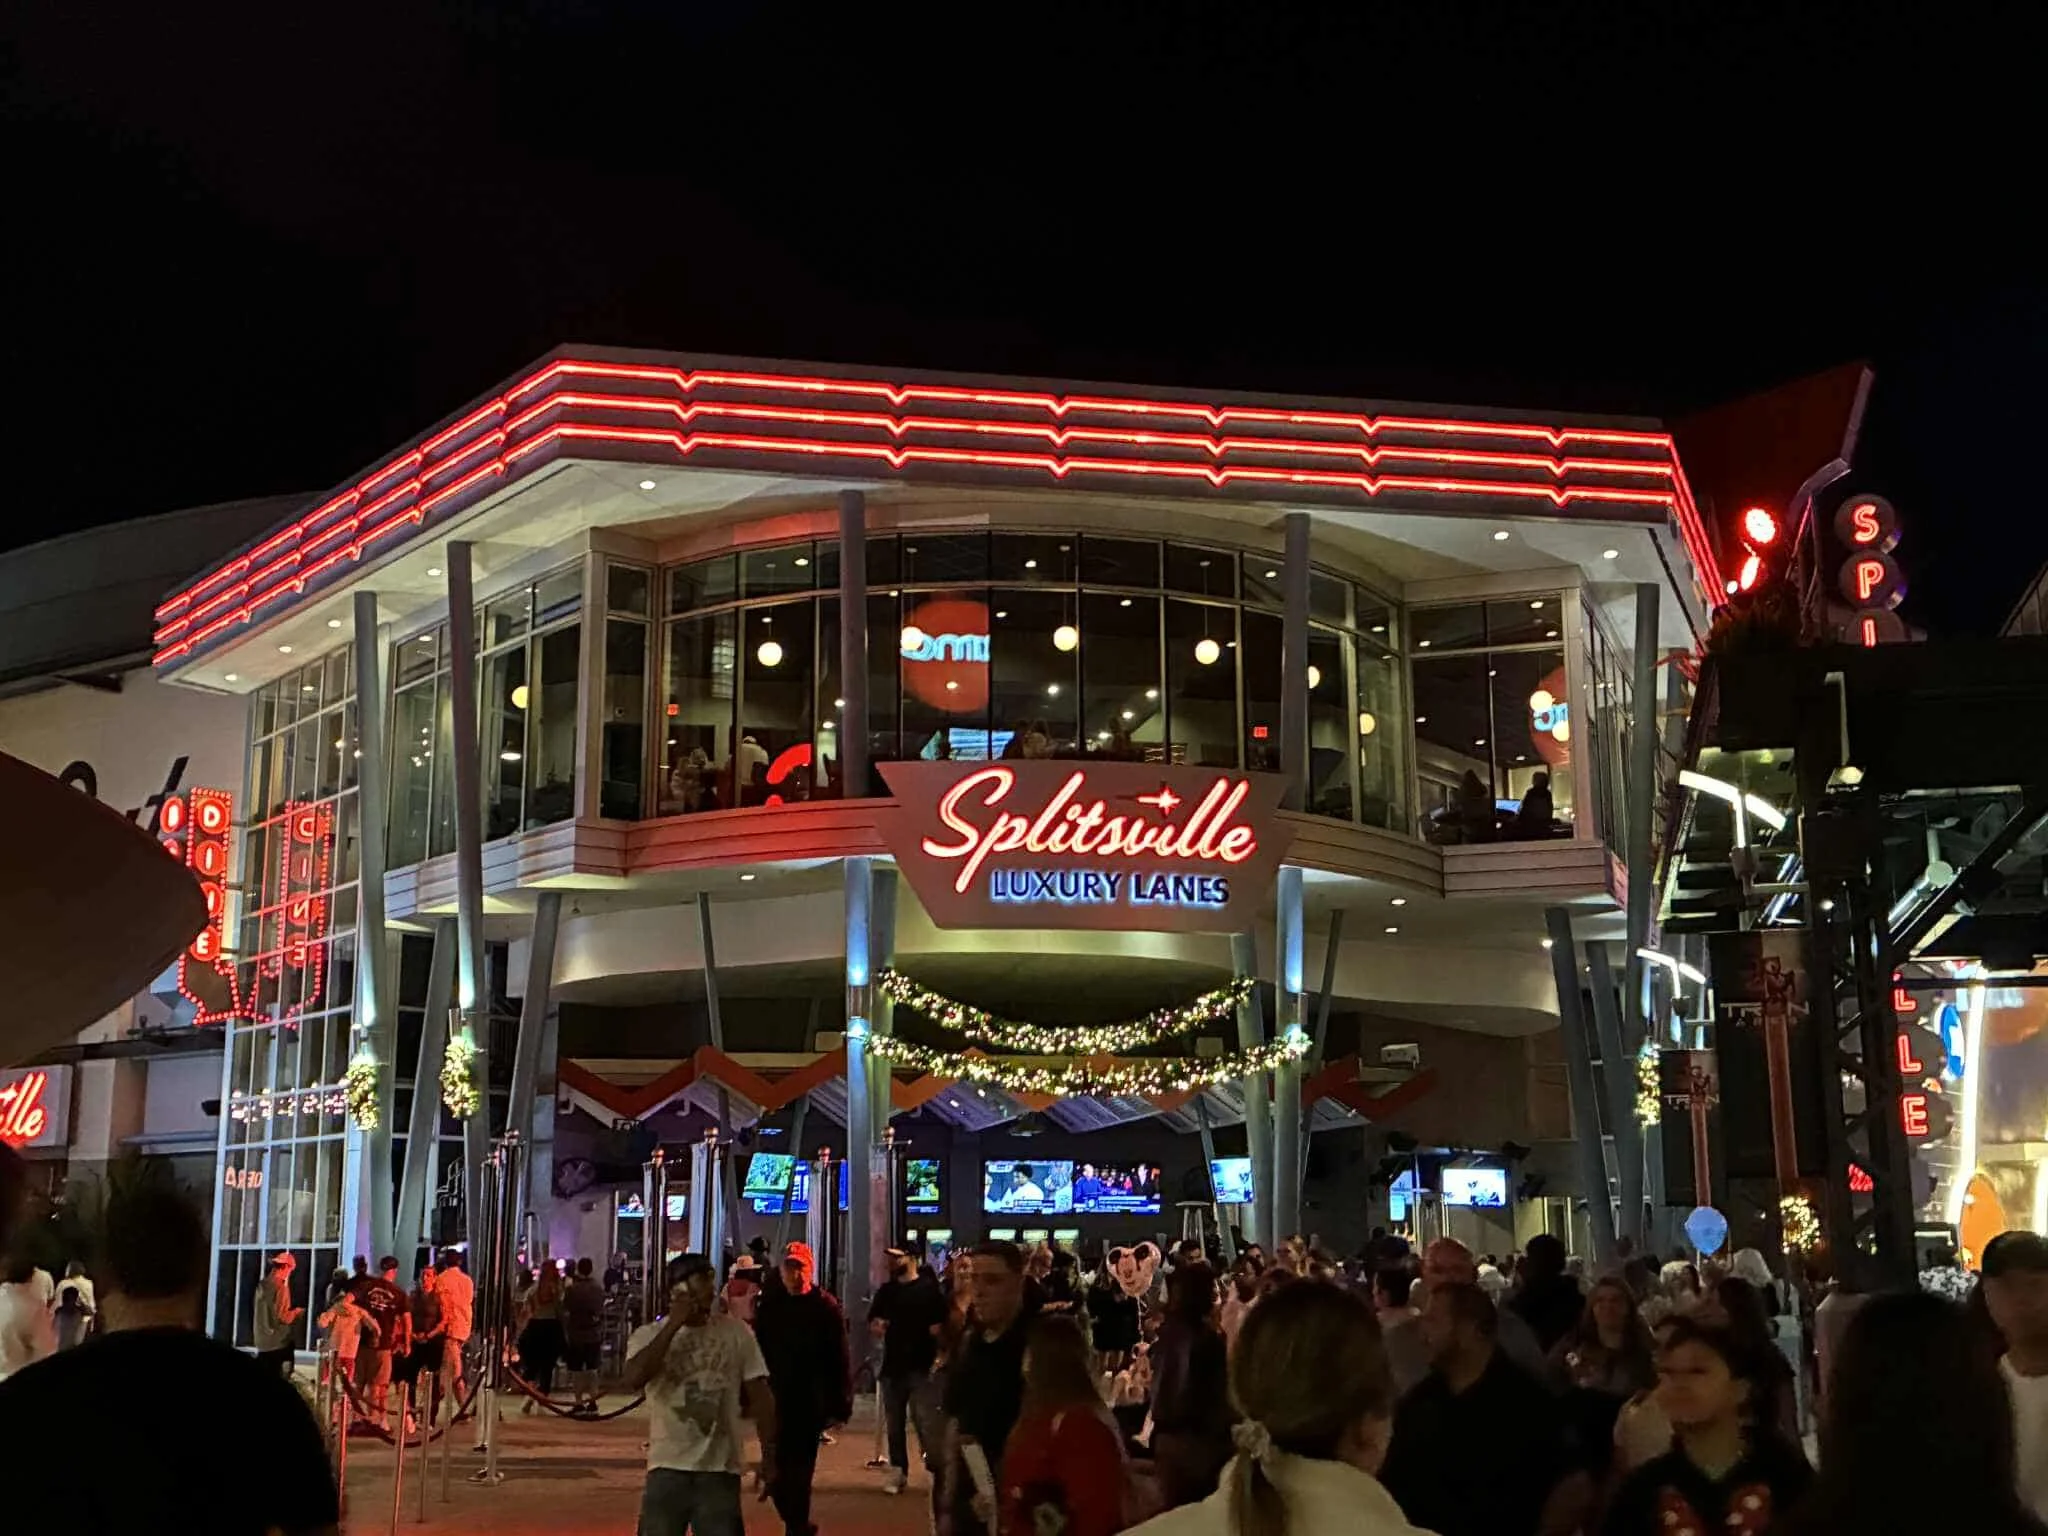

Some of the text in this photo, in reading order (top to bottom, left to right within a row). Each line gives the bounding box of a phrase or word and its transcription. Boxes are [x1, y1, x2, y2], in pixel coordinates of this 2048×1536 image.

[922, 766, 1258, 895] Splitsville
[990, 870, 1229, 908] LUXURY LANES
[1719, 1000, 1809, 1018] TRN
